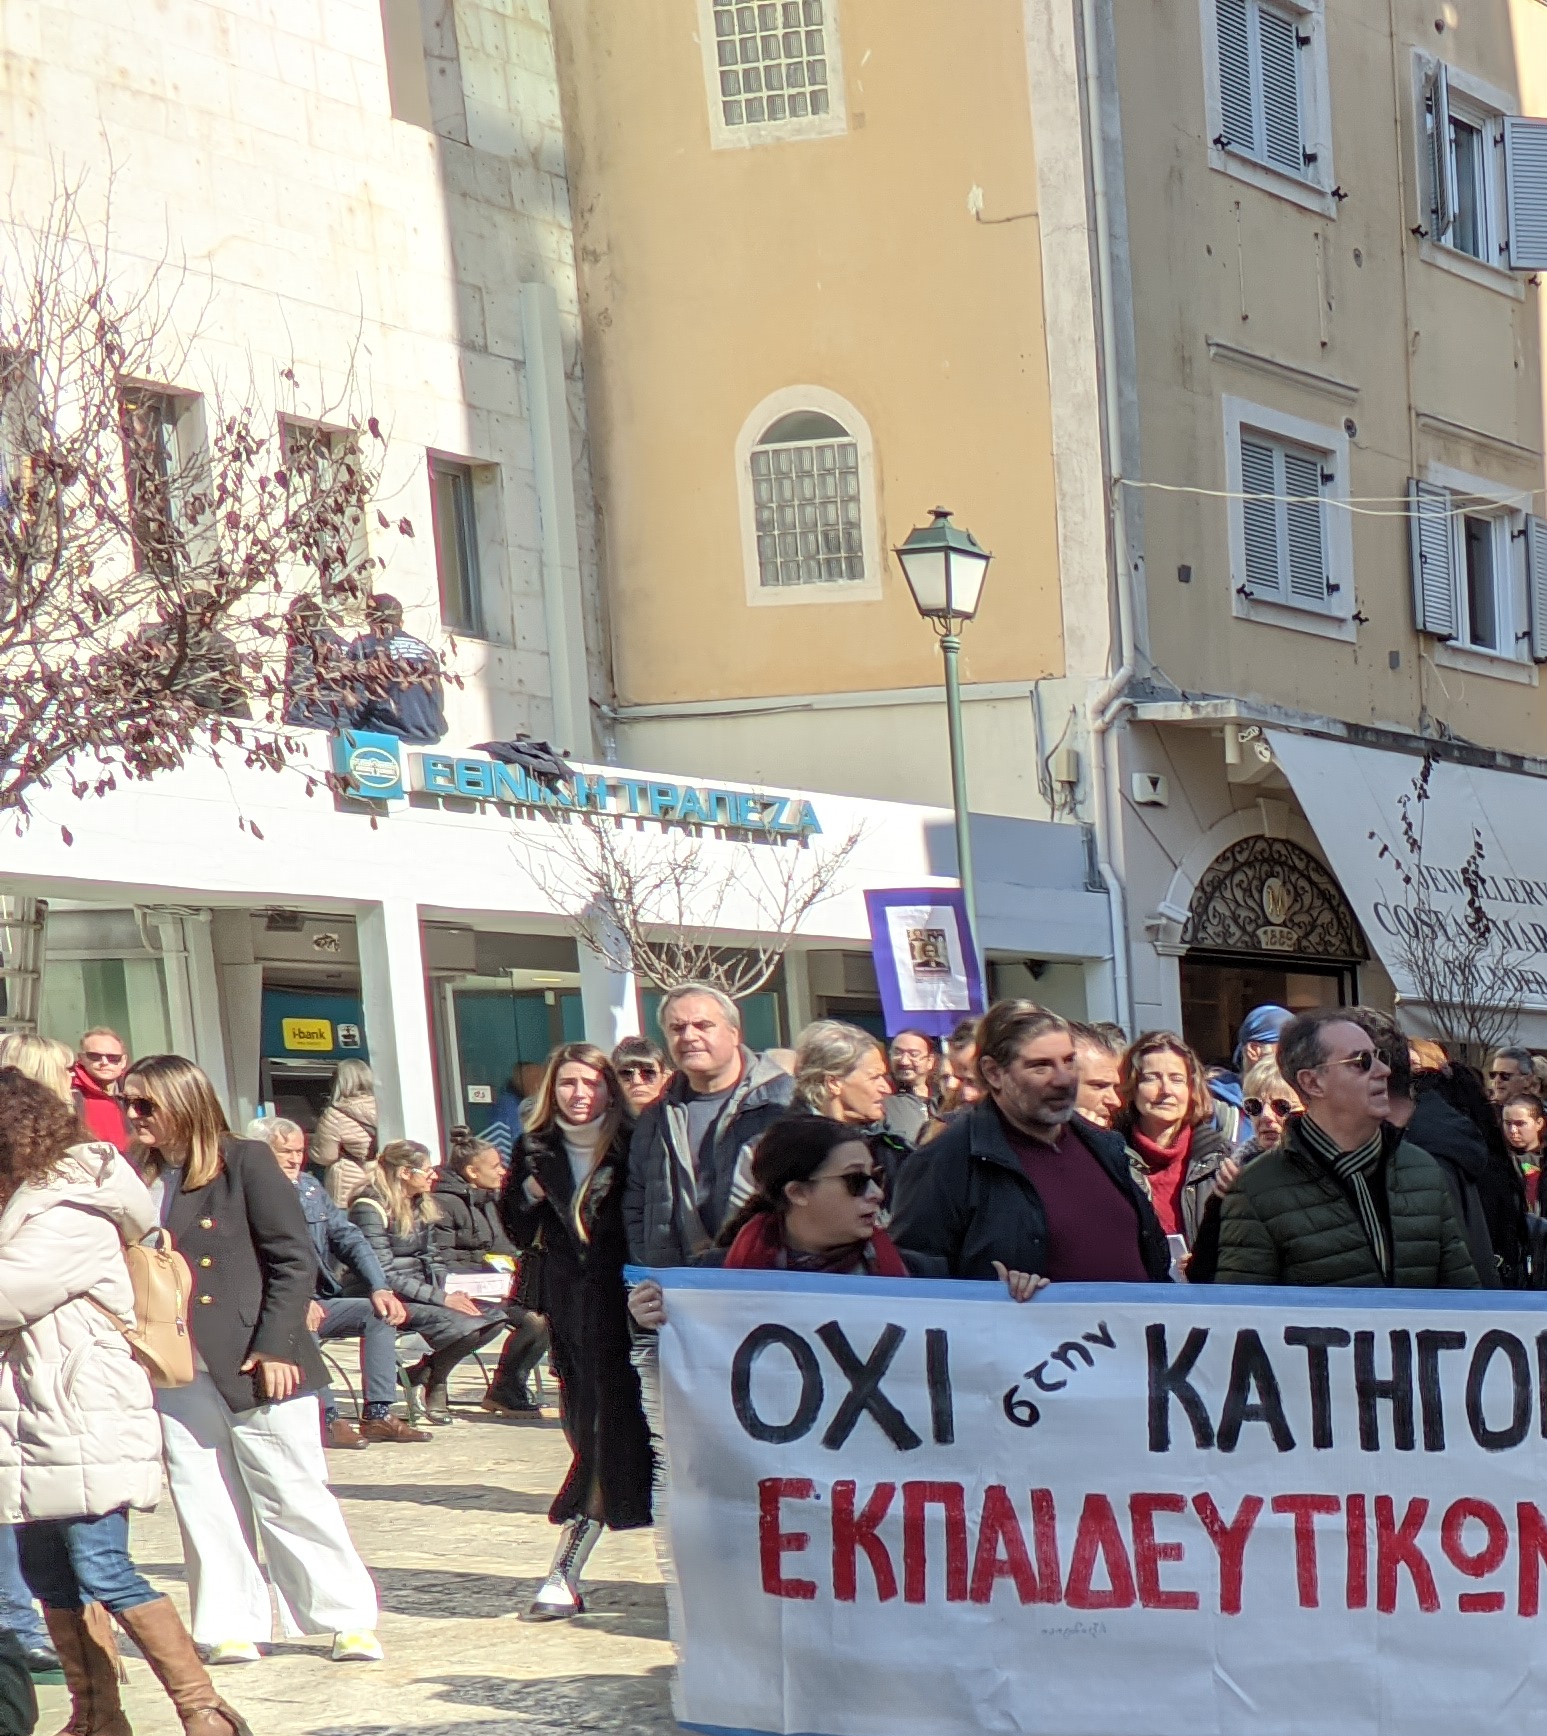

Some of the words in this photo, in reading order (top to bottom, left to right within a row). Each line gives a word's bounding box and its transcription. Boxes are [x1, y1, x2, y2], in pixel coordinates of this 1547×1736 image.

[616, 778, 823, 834] ΤΡΑΠΕΖΑ
[292, 1028, 326, 1040] i-bank
[730, 1319, 956, 1451] ΟΧΙ
